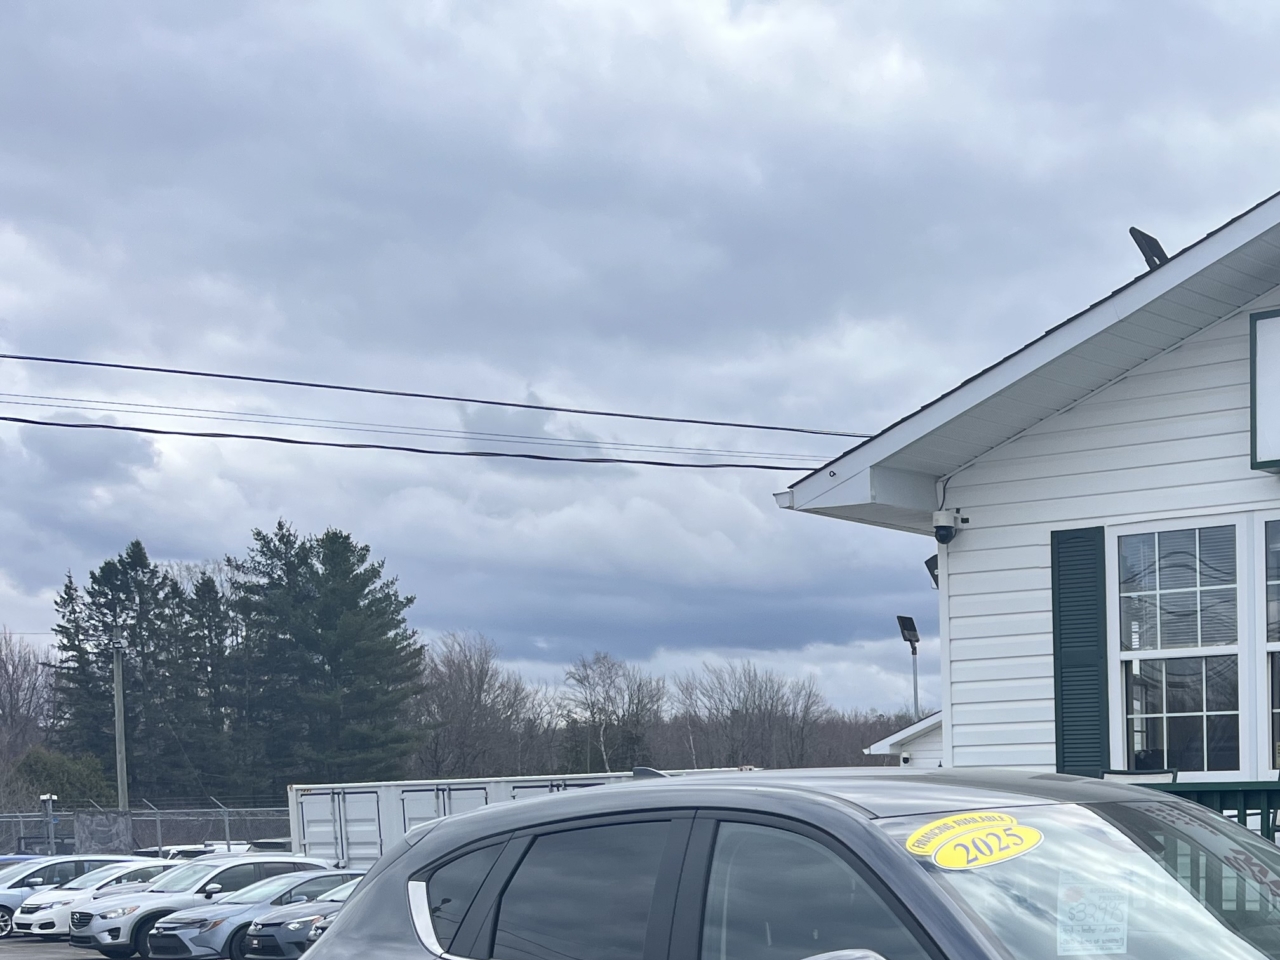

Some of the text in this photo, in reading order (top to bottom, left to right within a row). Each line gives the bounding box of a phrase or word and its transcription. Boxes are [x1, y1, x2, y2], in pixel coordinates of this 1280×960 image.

[912, 814, 1007, 849] FINANCING AVAILABLE
[953, 827, 1024, 865] 2025
